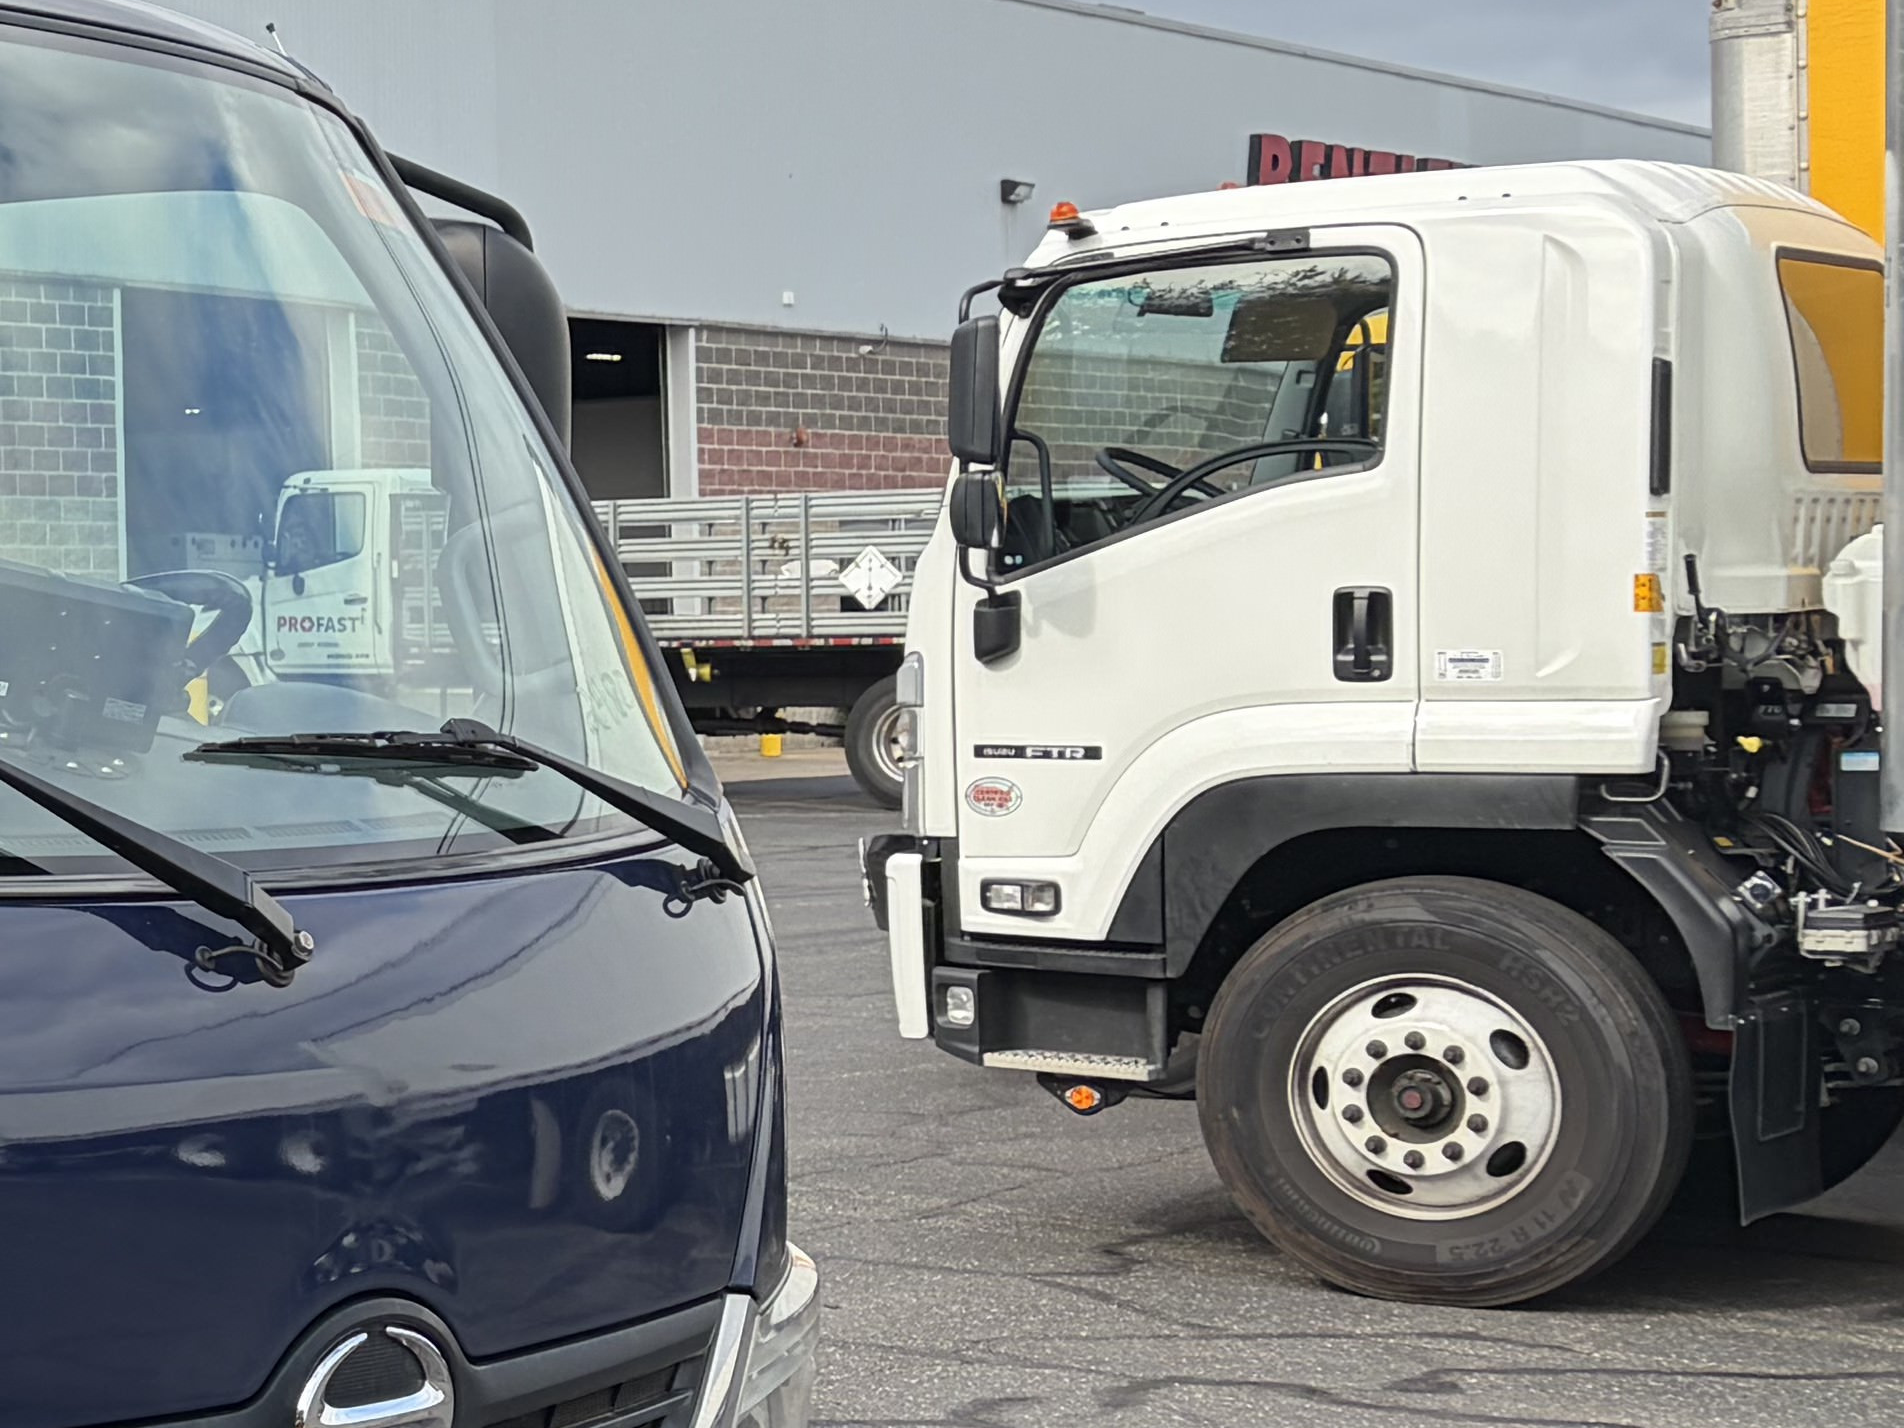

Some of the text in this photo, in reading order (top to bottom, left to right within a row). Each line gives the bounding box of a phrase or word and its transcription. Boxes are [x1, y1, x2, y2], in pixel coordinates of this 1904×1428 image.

[983, 746, 1086, 759] ISUZU FTR
[1251, 927, 1452, 1040] CONTINENTAL
